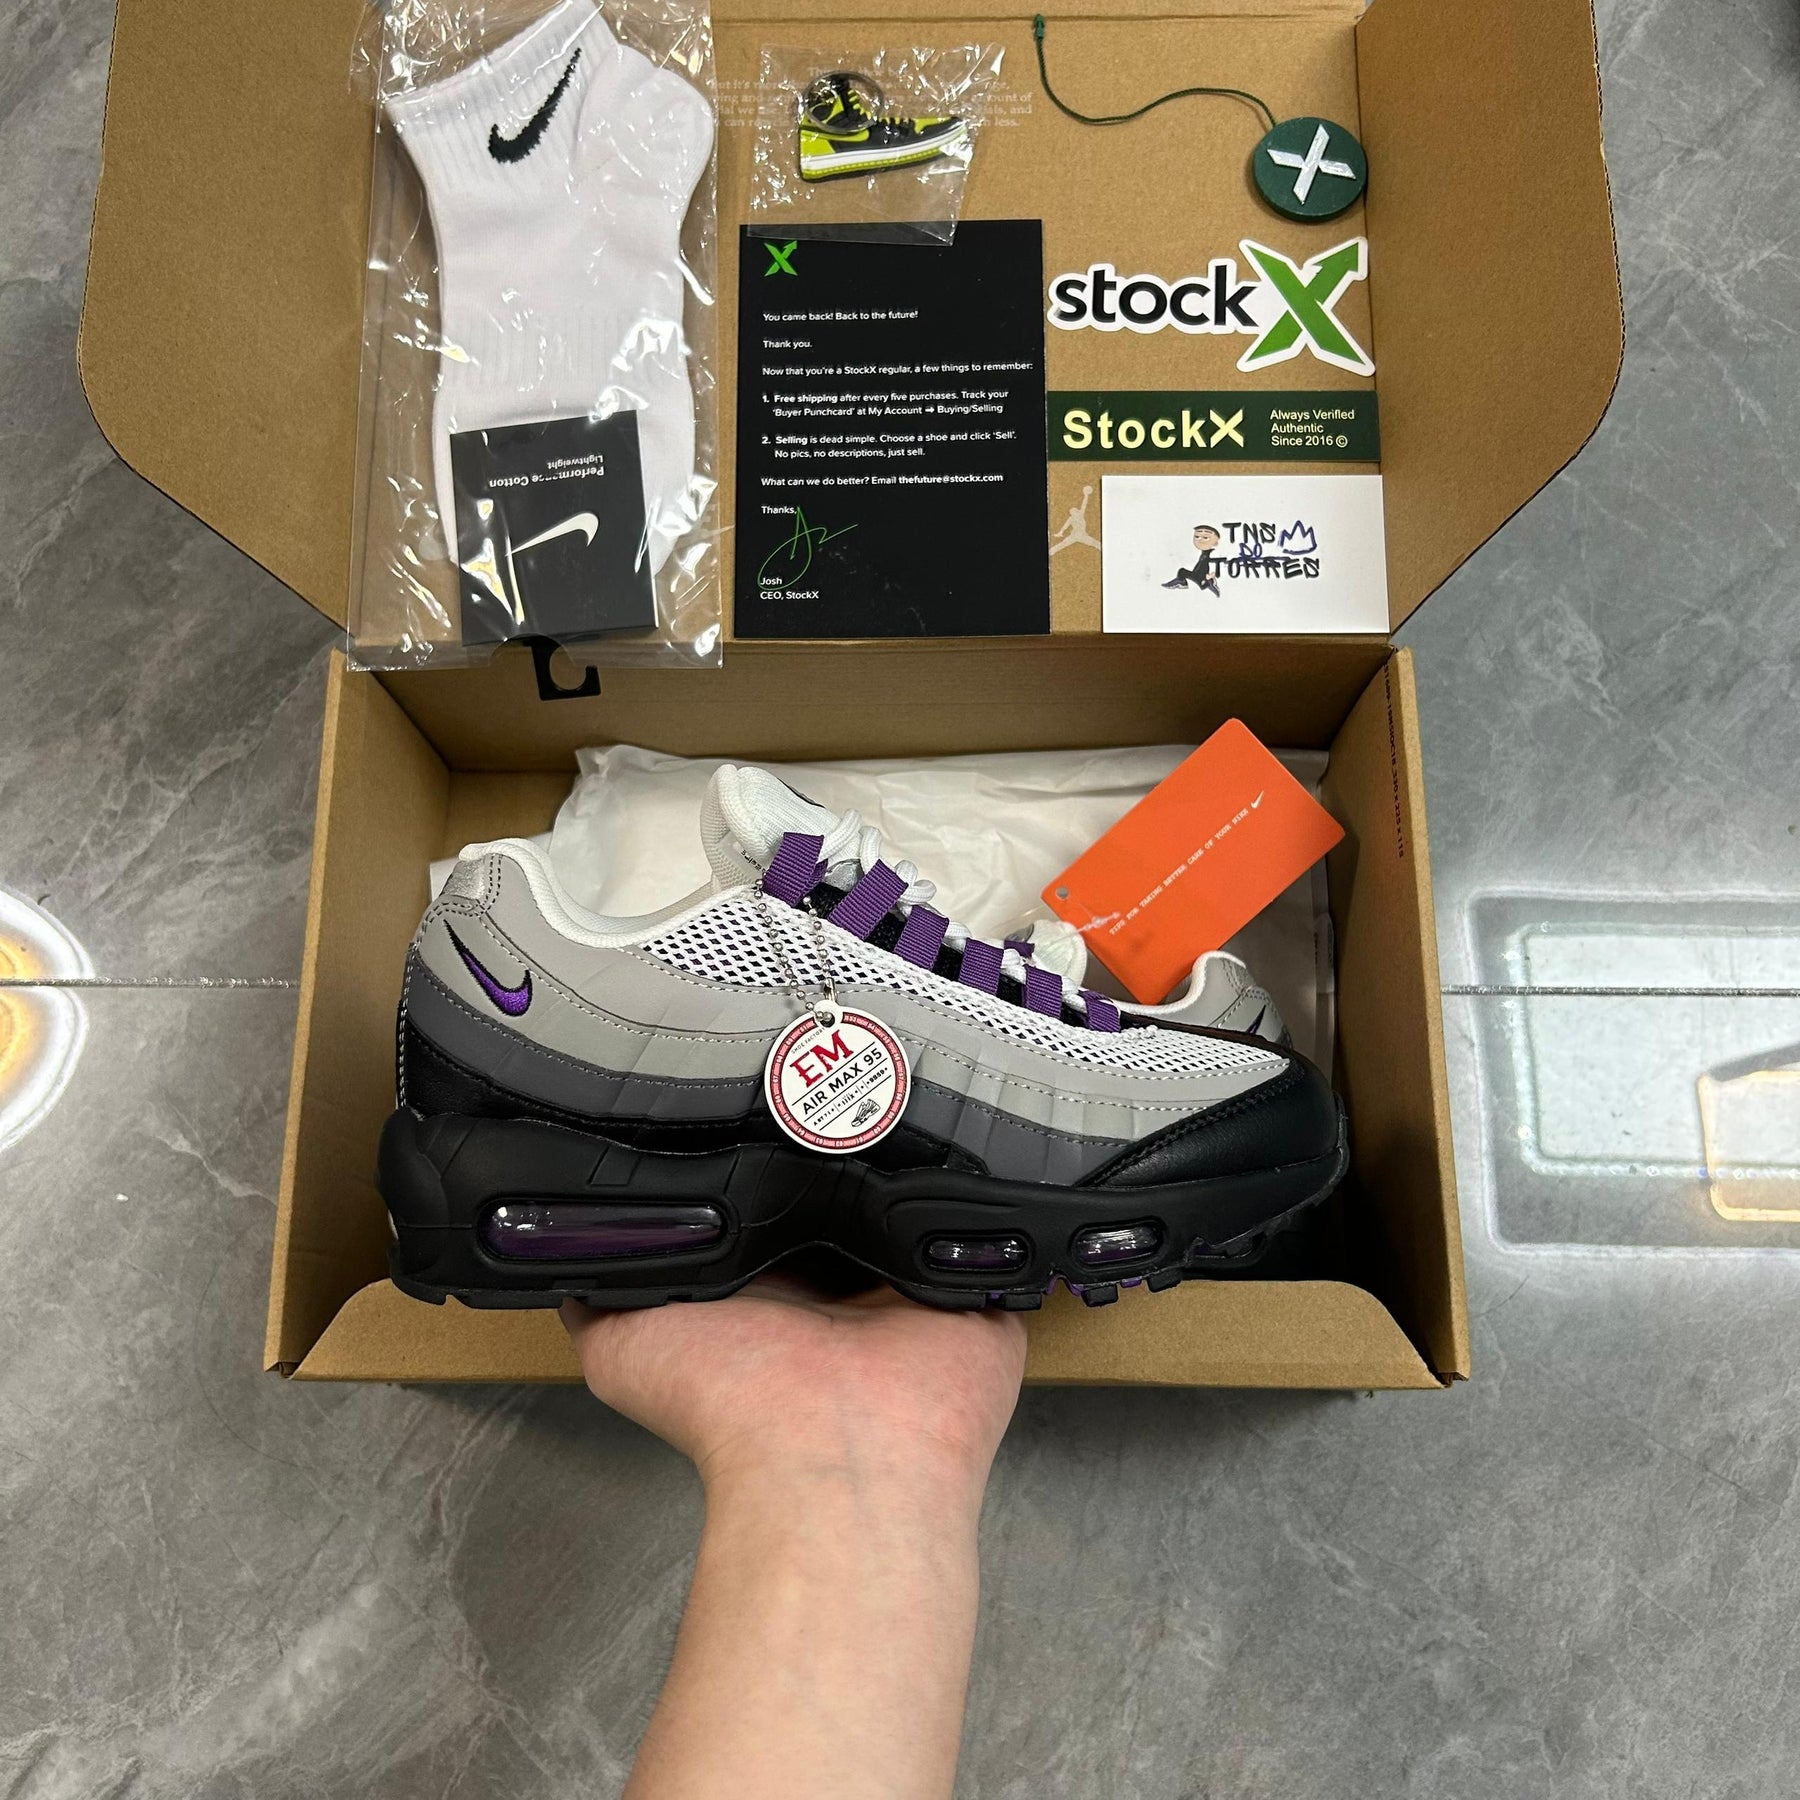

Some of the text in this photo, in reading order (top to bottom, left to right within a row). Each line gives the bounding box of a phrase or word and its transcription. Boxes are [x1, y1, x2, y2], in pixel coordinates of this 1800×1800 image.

[1010, 104, 1032, 114] and
[724, 118, 745, 127] can
[762, 310, 919, 322] You came back! Back to the future!
[762, 339, 813, 350] Thank you.
[762, 361, 1033, 377] Now that you're a StockX regular, a few things to remember:
[762, 390, 1009, 404] 1. Free shipping after every five purchases. Track your
[856, 407, 867, 416] at
[867, 406, 883, 417] My
[883, 406, 923, 415] Account
[937, 403, 1004, 415] Buying/Selling
[1270, 408, 1355, 422] Always Verified
[1063, 408, 1244, 449] StockX
[1270, 422, 1324, 433] Authentic
[761, 435, 772, 445] 2.
[775, 435, 808, 446] Selling
[809, 435, 818, 444] is
[819, 435, 844, 444] dead
[845, 434, 878, 445] simple.
[879, 434, 916, 443] Choose
[917, 434, 924, 442] a
[925, 433, 949, 442] shoe
[949, 432, 968, 441] and
[969, 431, 991, 441] click
[1270, 435, 1303, 447] Since
[1305, 435, 1333, 446] 2016
[774, 447, 926, 459] No pics, no descriptions, just sell.
[547, 454, 604, 470] Lightweight
[489, 476, 529, 488] Cotton
[760, 474, 1004, 487] What can we do better? Email thefuture@stockx.com
[760, 505, 797, 515] Thanks,
[1222, 522, 1276, 543] TNS
[759, 577, 783, 586] Josh
[759, 589, 820, 601] CEO, StockX
[789, 1029, 855, 1089] EM
[803, 1090, 828, 1116] AIR
[829, 1063, 863, 1094] MAX
[863, 1047, 883, 1067] 95
